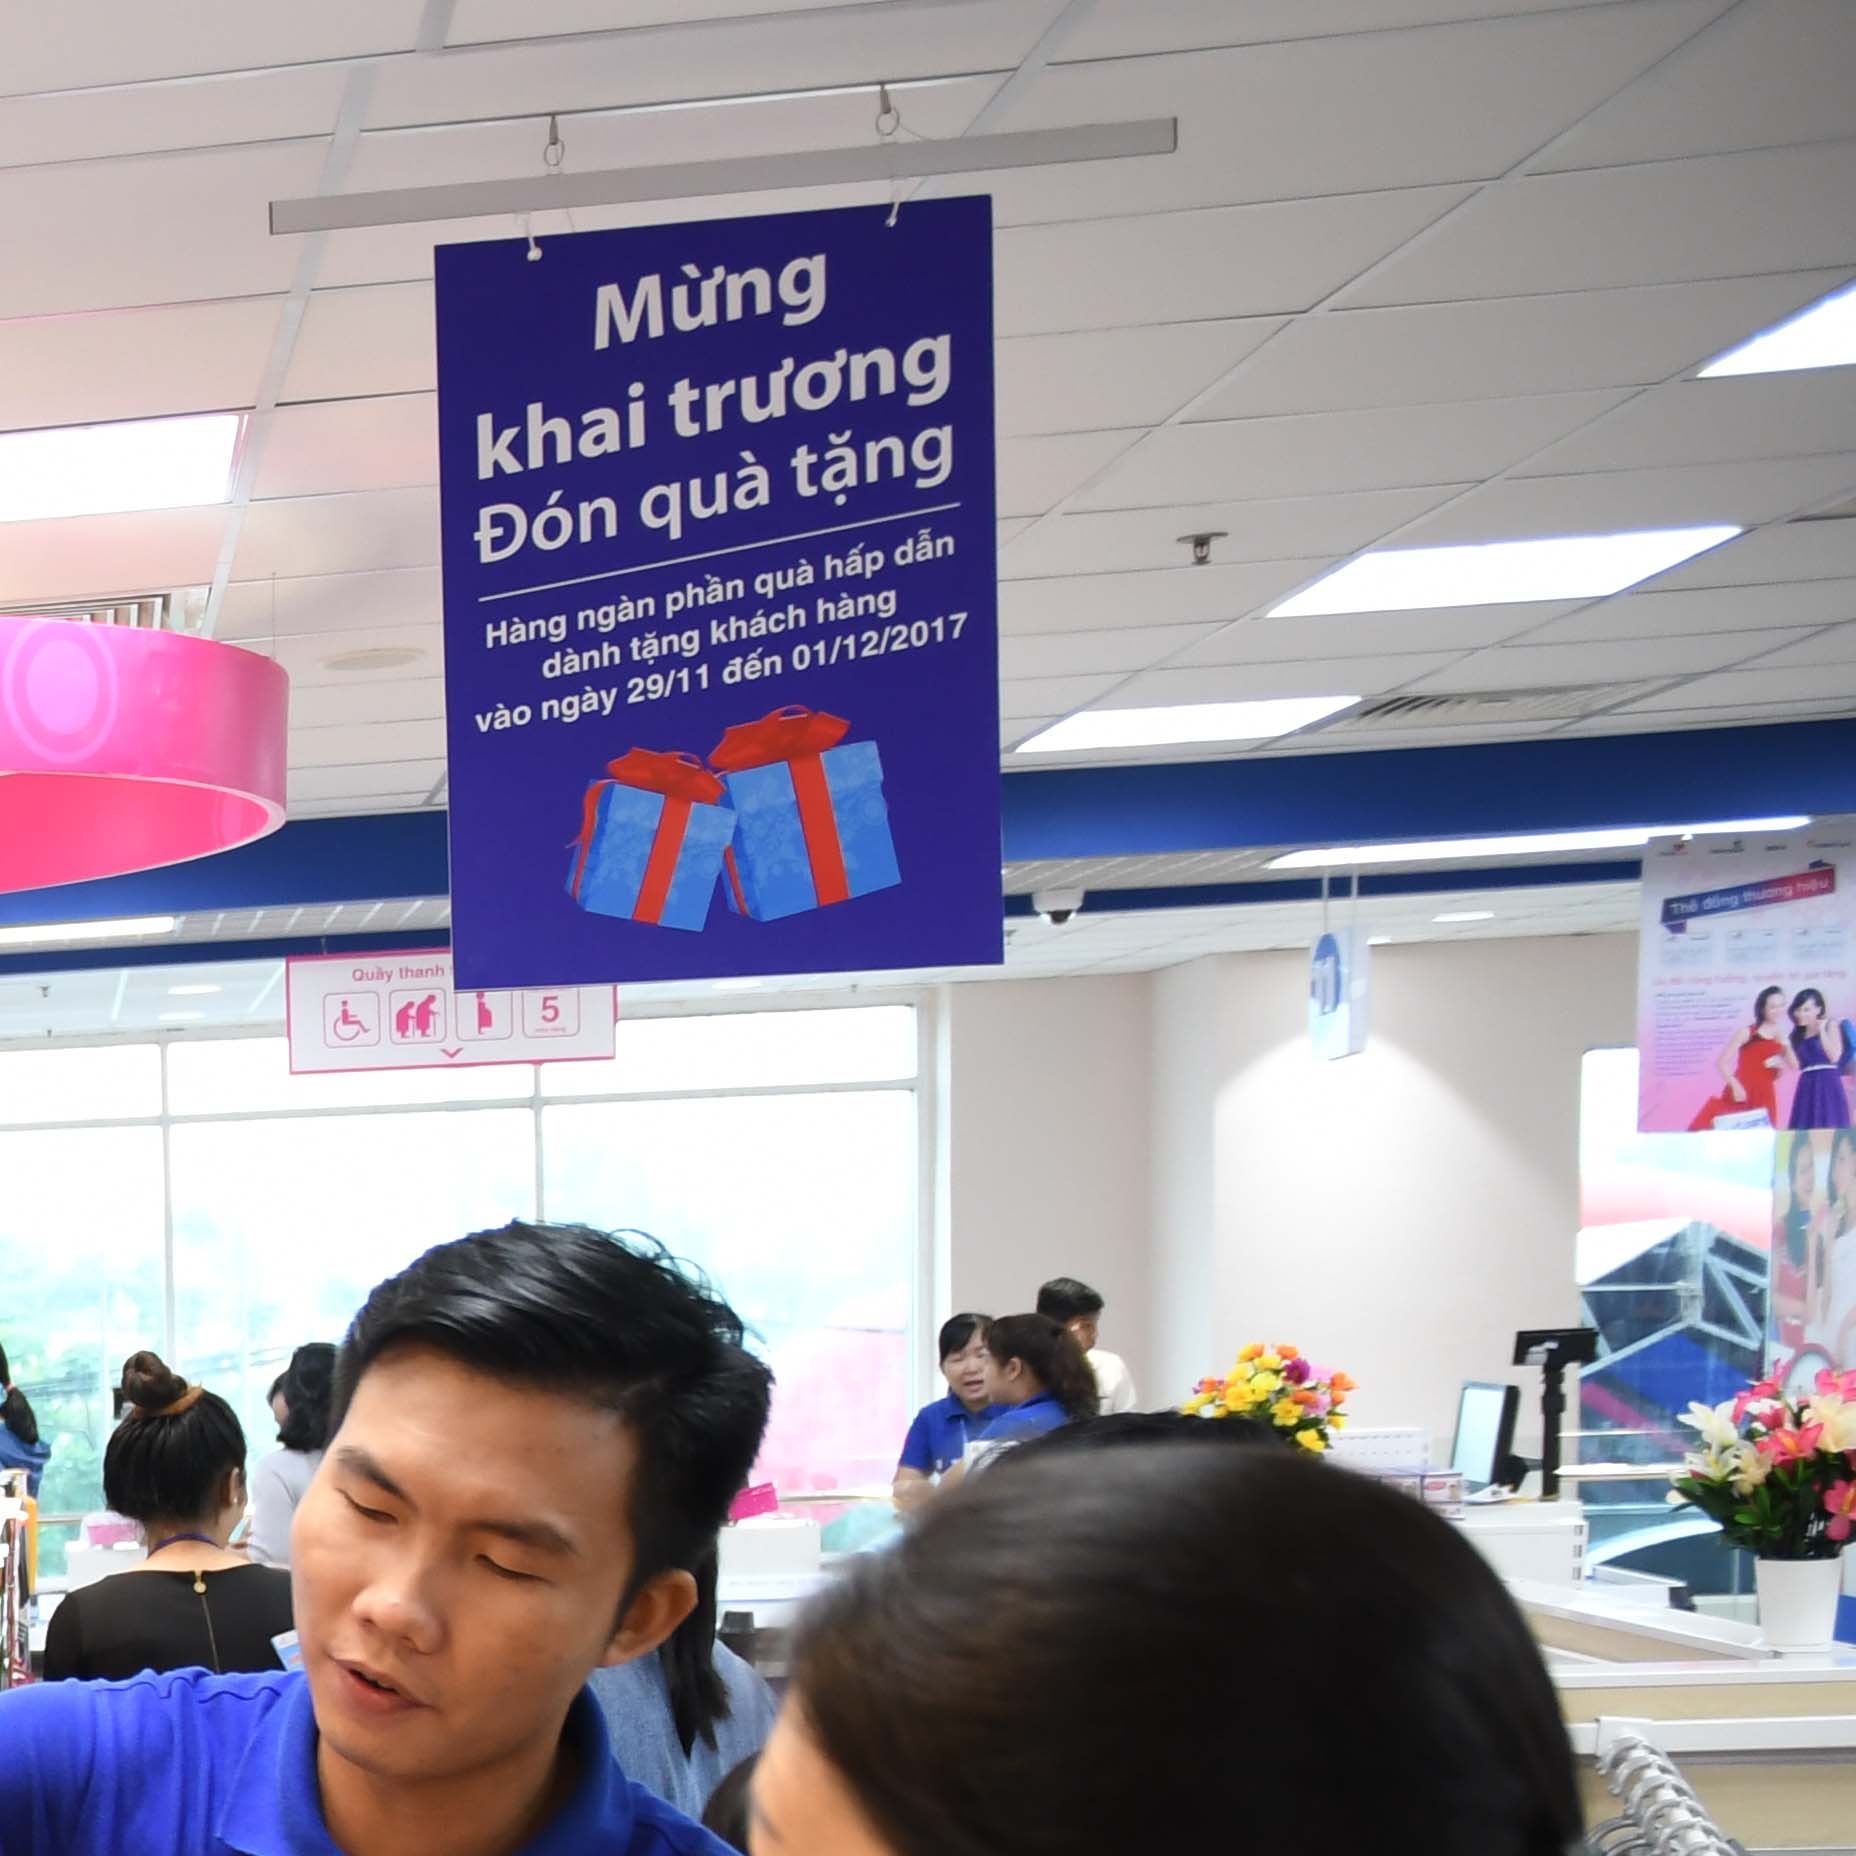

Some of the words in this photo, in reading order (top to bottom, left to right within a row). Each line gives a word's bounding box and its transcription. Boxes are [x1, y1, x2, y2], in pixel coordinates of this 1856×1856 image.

[594, 252, 827, 350] Mừng
[476, 382, 646, 480] khai
[668, 333, 952, 438] trương
[474, 488, 618, 566] Đón
[640, 451, 771, 541] quà
[791, 425, 955, 506] tặng
[485, 615, 568, 649] Hàng
[577, 598, 656, 633] ngàn
[666, 575, 745, 619] phần
[754, 560, 814, 601] quà
[824, 543, 885, 580] hấp
[894, 529, 956, 567] dẫn
[542, 644, 621, 679] dành
[630, 627, 701, 661] tặng
[710, 602, 807, 645] khách
[817, 588, 899, 626] hàng
[475, 700, 532, 733] vào
[541, 686, 617, 723] ngày
[627, 664, 710, 703] 29/11
[722, 646, 783, 687] đến
[793, 611, 969, 672] 01/12/2017
[398, 965, 446, 980] thanh
[541, 995, 561, 1023] 5
